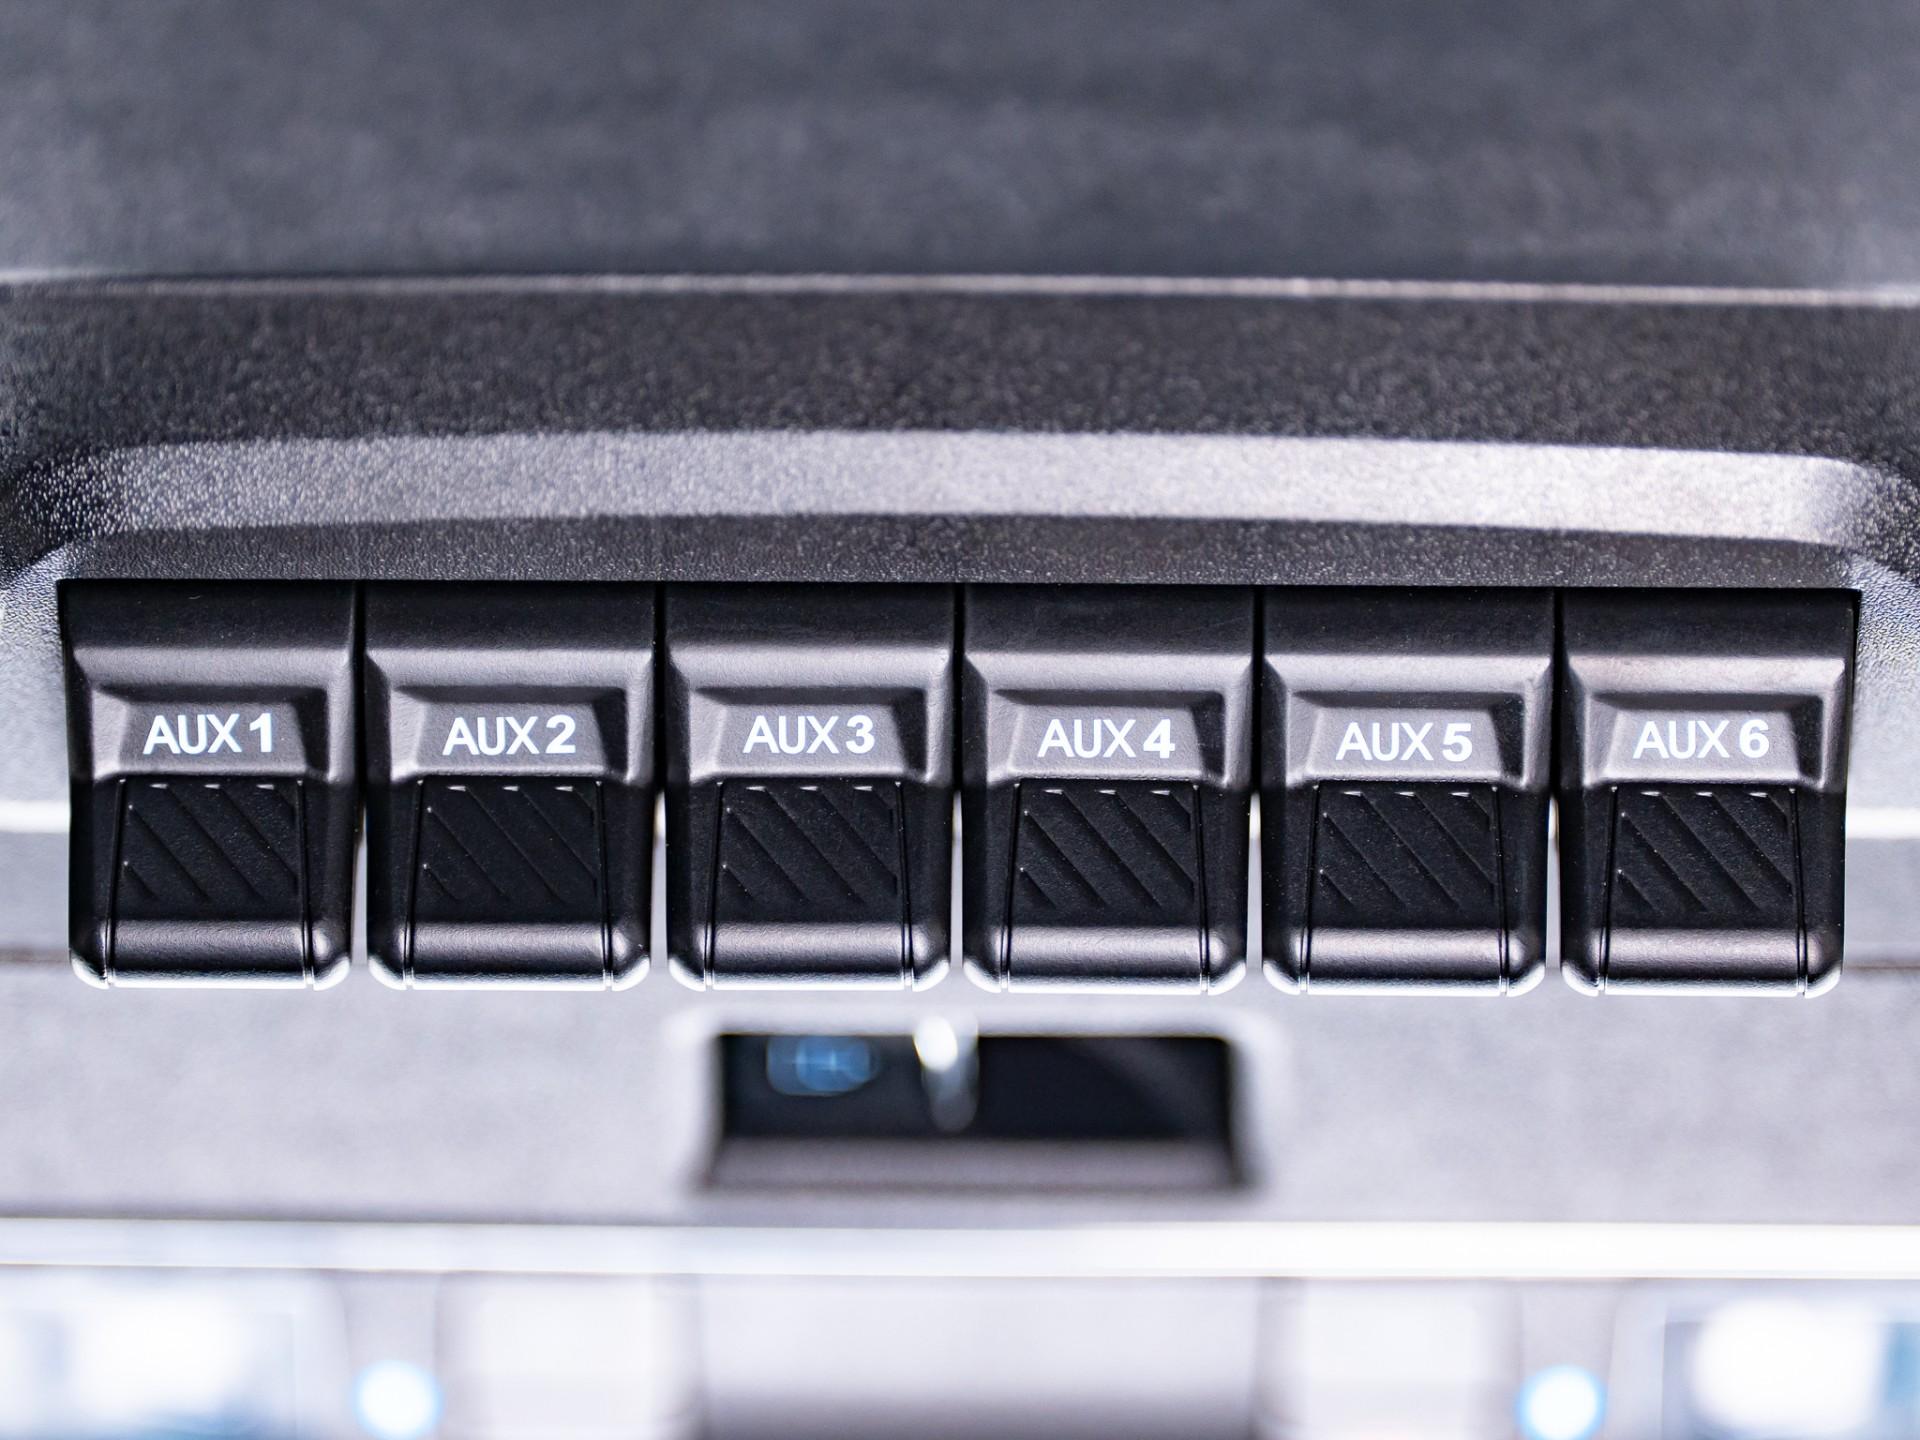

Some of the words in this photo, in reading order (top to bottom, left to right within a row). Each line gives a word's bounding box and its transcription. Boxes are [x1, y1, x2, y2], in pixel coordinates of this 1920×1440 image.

[142, 713, 243, 755] AUX
[249, 712, 273, 753] 1
[442, 715, 541, 756] AUX
[545, 713, 577, 754] 2
[742, 714, 841, 755] AUX
[844, 714, 876, 755] 3
[1036, 718, 1139, 759] AUX
[1140, 718, 1177, 760] 4
[1335, 721, 1434, 762] AUX
[1441, 722, 1473, 762] 5
[1632, 719, 1730, 759] AUX
[1738, 718, 1770, 758] 6
